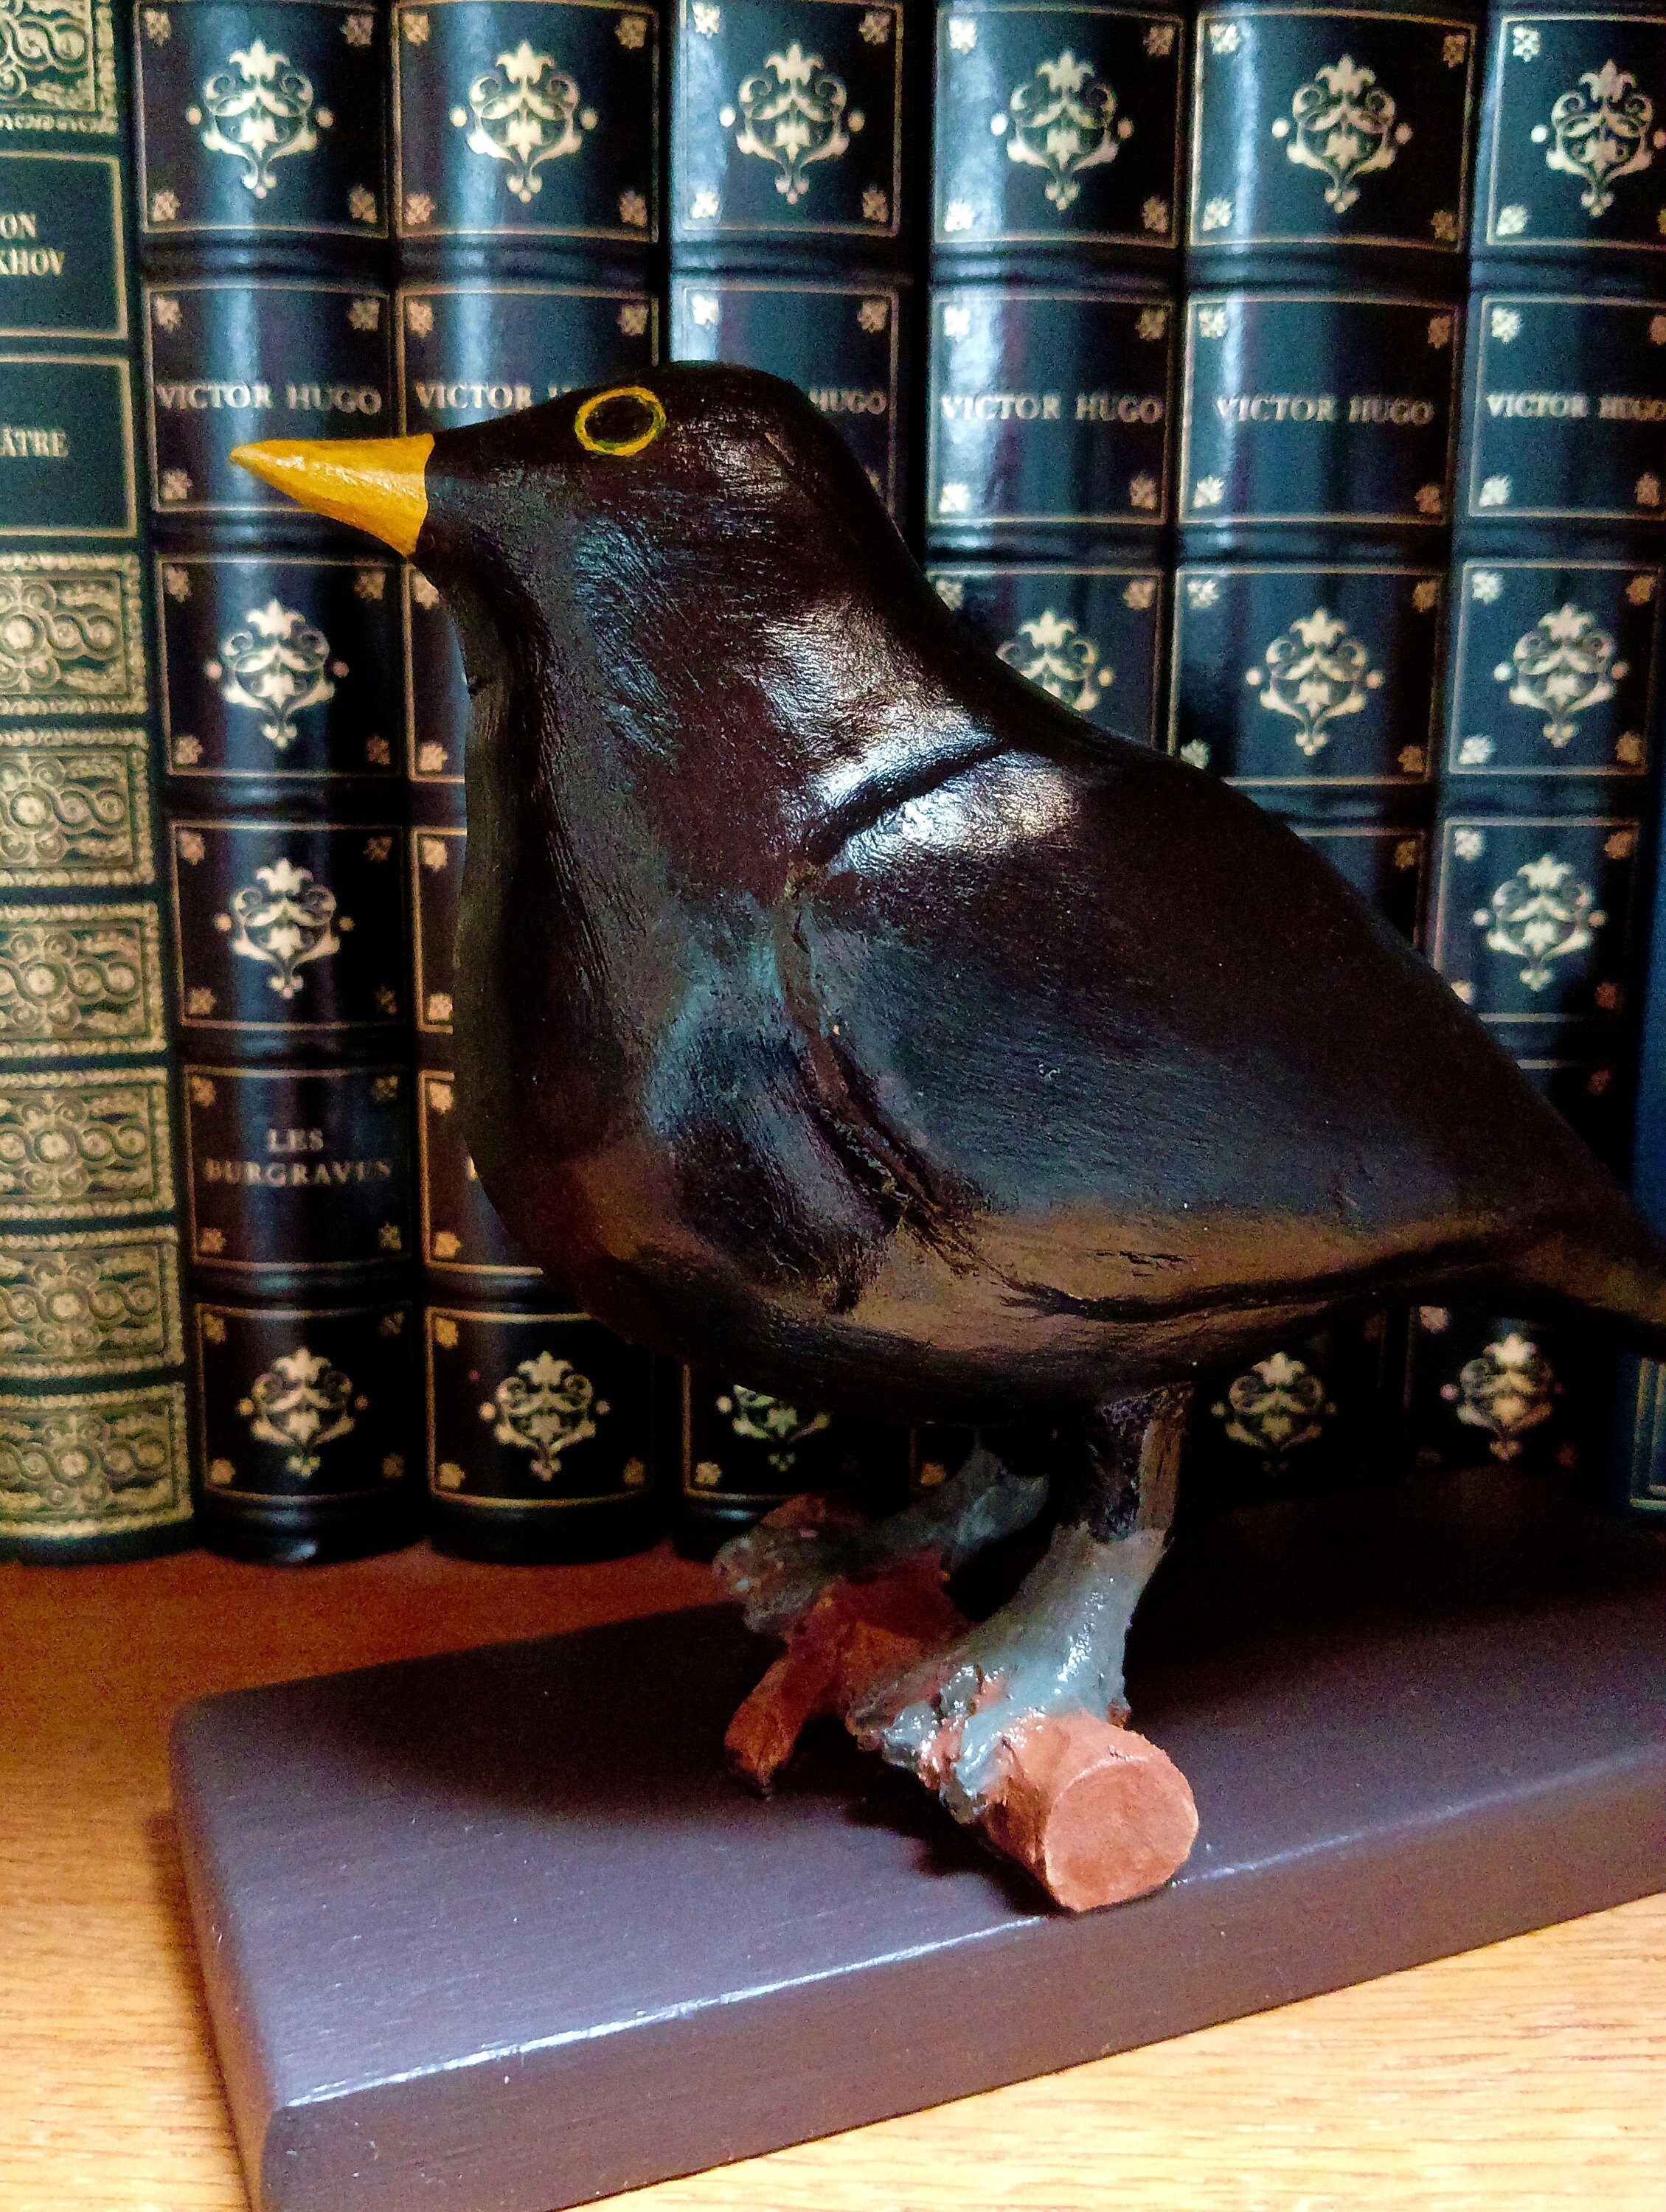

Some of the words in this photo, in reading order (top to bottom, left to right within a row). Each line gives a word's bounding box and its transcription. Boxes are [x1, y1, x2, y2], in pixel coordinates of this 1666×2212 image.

[156, 383, 272, 410] VICTOR
[286, 383, 383, 415] HUGO
[415, 383, 532, 410] VICTOR
[941, 394, 1062, 420] VICTOR
[1076, 395, 1163, 424] HUGO
[1217, 395, 1337, 422] VICTOR
[1349, 396, 1435, 425] HUGO
[1486, 393, 1589, 419] VICTOR
[266, 1128, 324, 1153] LES
